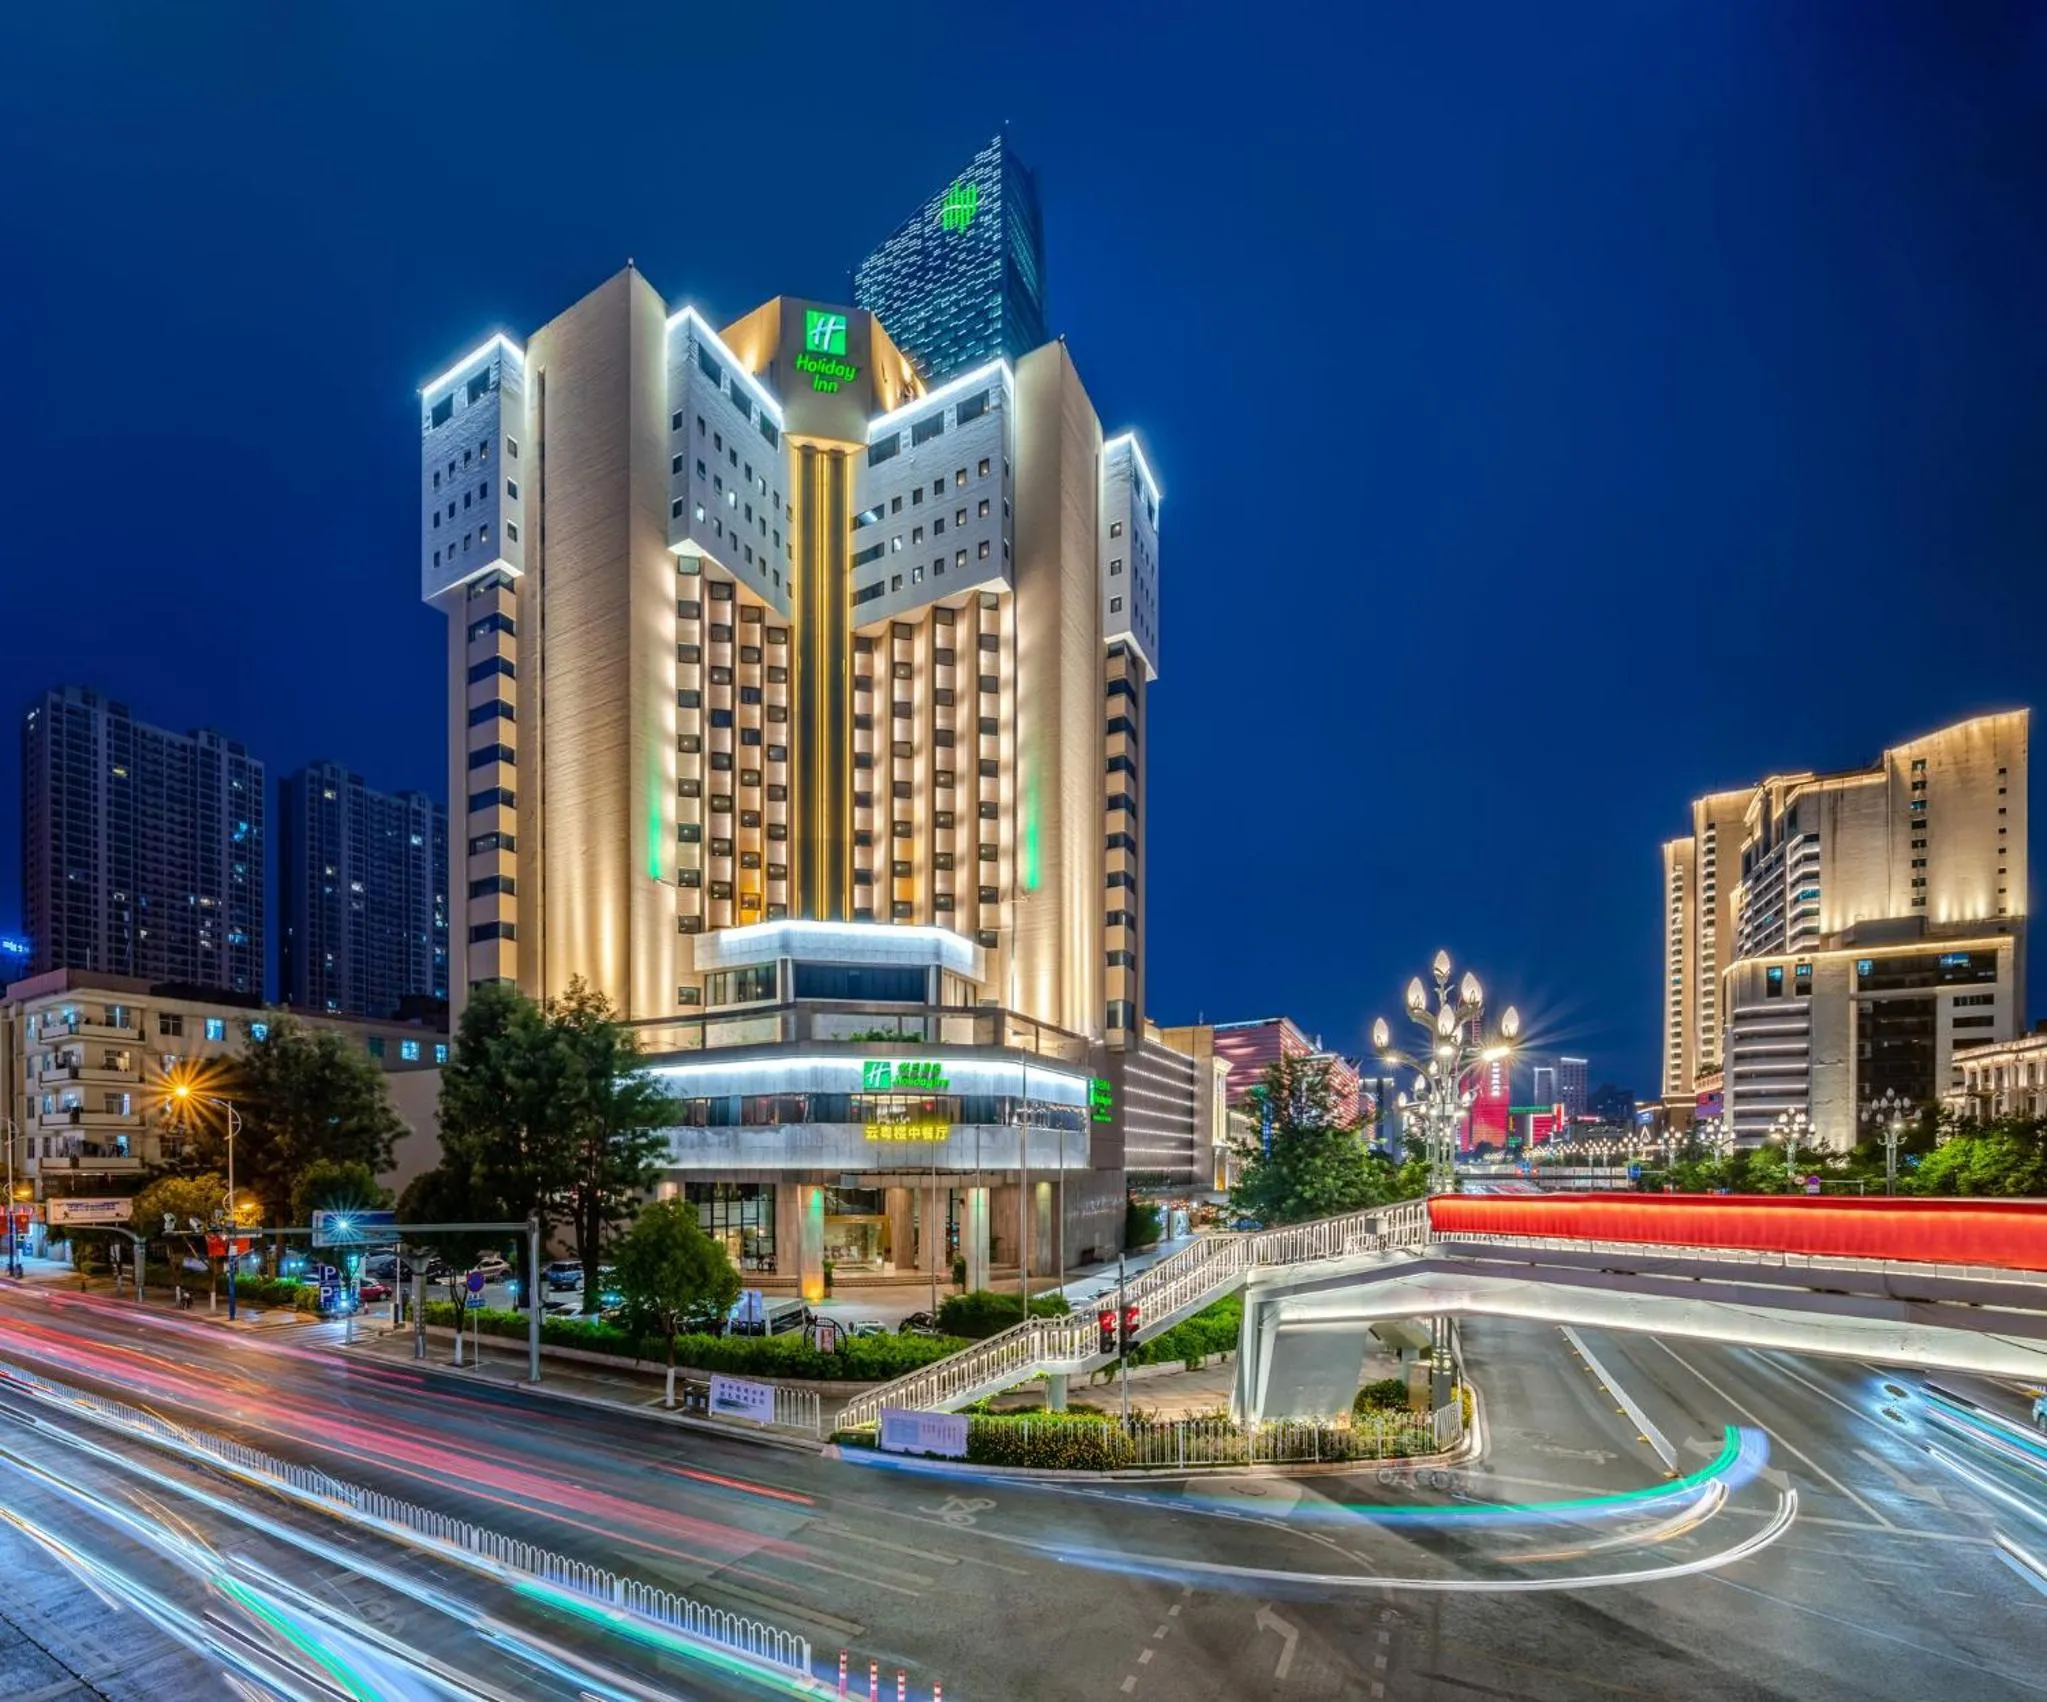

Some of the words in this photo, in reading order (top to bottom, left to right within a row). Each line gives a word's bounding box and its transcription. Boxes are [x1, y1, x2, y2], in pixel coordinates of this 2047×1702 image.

[796, 353, 857, 382] Holiday
[813, 374, 838, 393] Inn
[324, 1265, 337, 1281] P
[320, 1286, 333, 1303] P
